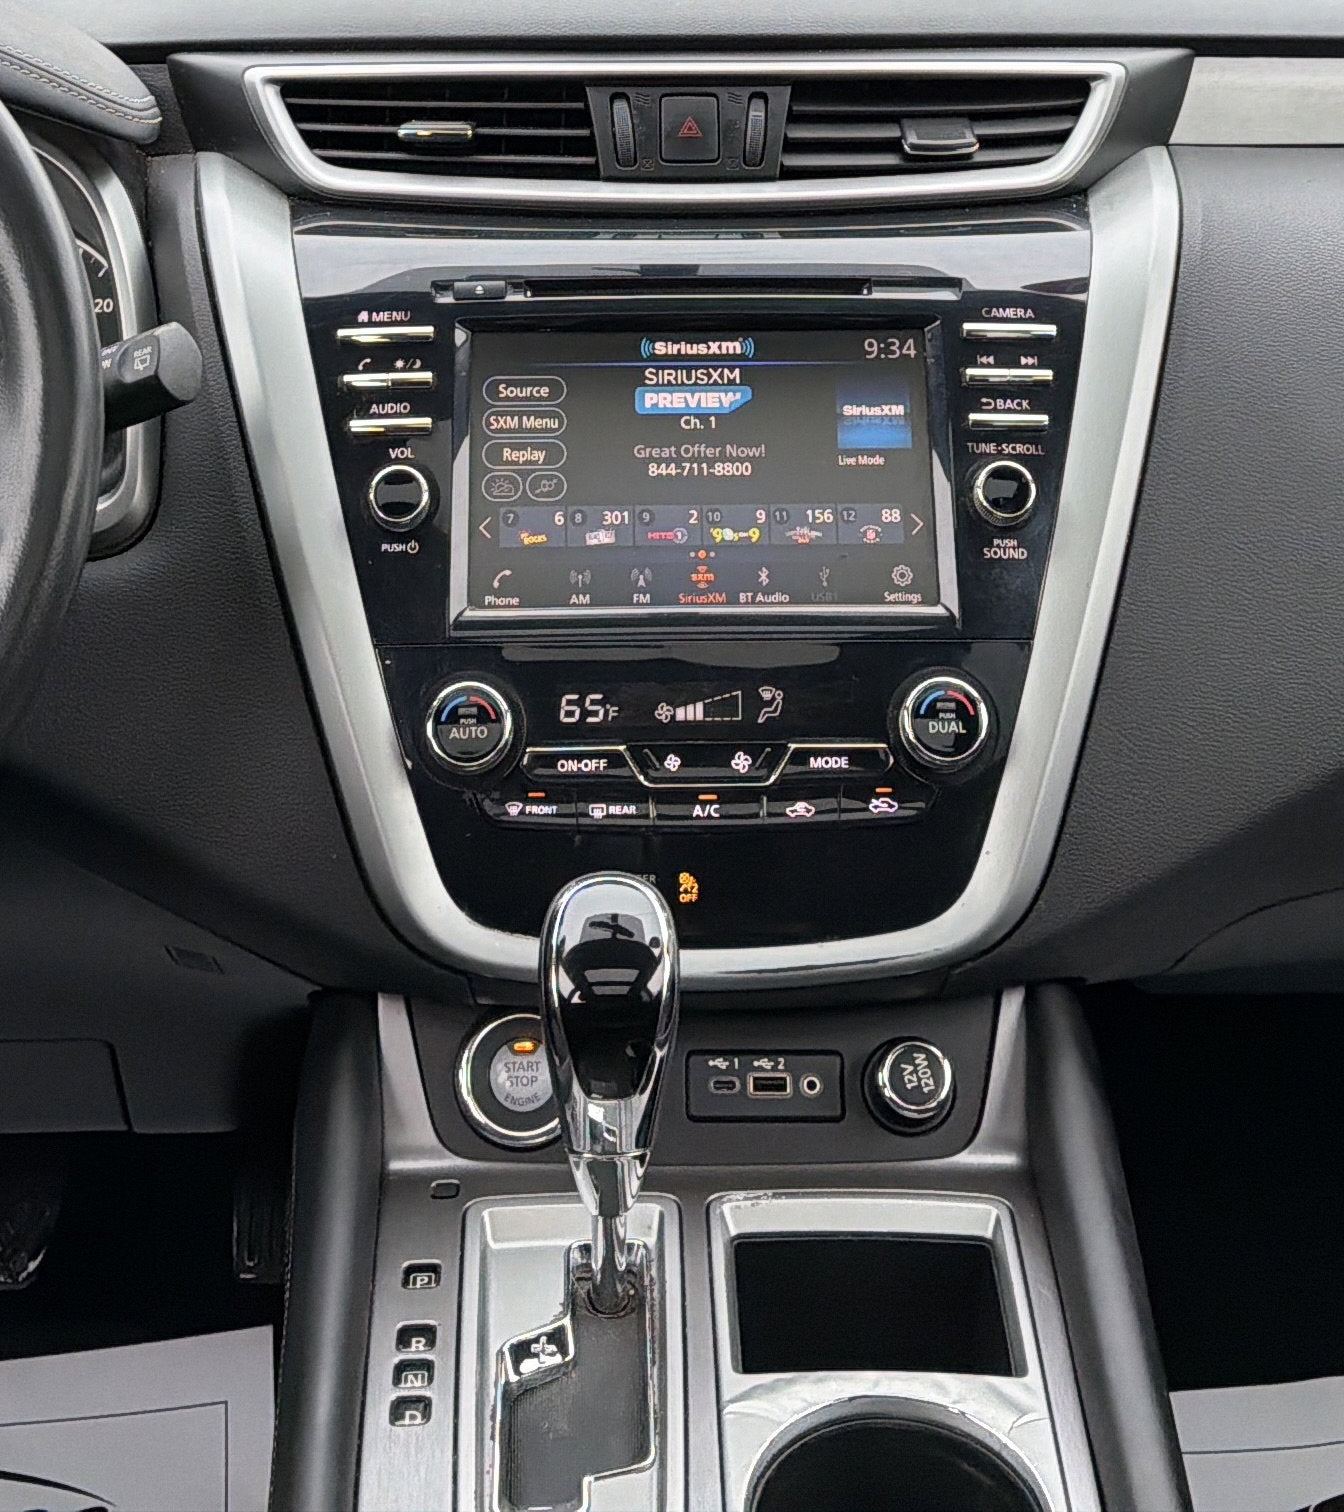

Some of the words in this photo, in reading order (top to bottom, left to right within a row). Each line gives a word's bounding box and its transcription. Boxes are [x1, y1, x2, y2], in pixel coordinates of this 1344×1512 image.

[371, 310, 411, 322] MENU
[981, 308, 1035, 319] CAMERA
[864, 339, 917, 359] 9:34
[498, 384, 550, 398] Source
[644, 392, 741, 408] PREVIEW
[995, 399, 1030, 410] BACK
[369, 402, 410, 414] AUDIO
[489, 416, 520, 430] SXM
[522, 416, 559, 430] Menu
[680, 416, 704, 429] Ch.
[709, 416, 716, 428] 1
[388, 448, 414, 459] VOL
[502, 448, 546, 465] Replay
[634, 445, 675, 458] Great
[681, 444, 721, 458] Offer
[726, 444, 766, 457] Now!
[838, 455, 857, 466] Live
[858, 455, 885, 466] Mode
[648, 462, 752, 476] 844-711-8800
[507, 514, 514, 524] 7
[554, 510, 565, 526] 6
[574, 512, 583, 523] 8
[602, 510, 629, 526] 301
[642, 511, 650, 523] 9
[688, 509, 698, 524] 2
[707, 511, 721, 522] 10
[756, 511, 766, 523] 9
[774, 511, 787, 521] 11
[806, 509, 833, 523] 156
[843, 511, 856, 521] 12
[881, 509, 901, 522] 88
[381, 542, 406, 553] PUSH
[993, 539, 1018, 548] PUSH
[983, 548, 1028, 560] SOUND
[484, 593, 520, 606] Phone
[569, 593, 590, 605] AM
[633, 593, 651, 604] FM
[678, 592, 726, 604] SiriusXM
[739, 592, 753, 603] BT
[755, 592, 790, 603] Audio
[884, 591, 922, 604] Settings
[448, 726, 488, 739] AUTO
[928, 721, 967, 734] DUAL
[809, 756, 850, 769] MODE
[525, 805, 558, 815] FRONT
[608, 804, 637, 815] REAR
[692, 804, 720, 818] A/C
[679, 894, 698, 903] OFF
[503, 1059, 542, 1075] START
[732, 1057, 740, 1070] 1
[776, 1057, 786, 1070] 2
[505, 1074, 539, 1089] STOP
[904, 1064, 920, 1092] 12V
[503, 1093, 542, 1107] ENGINE
[411, 1337, 427, 1350] R
